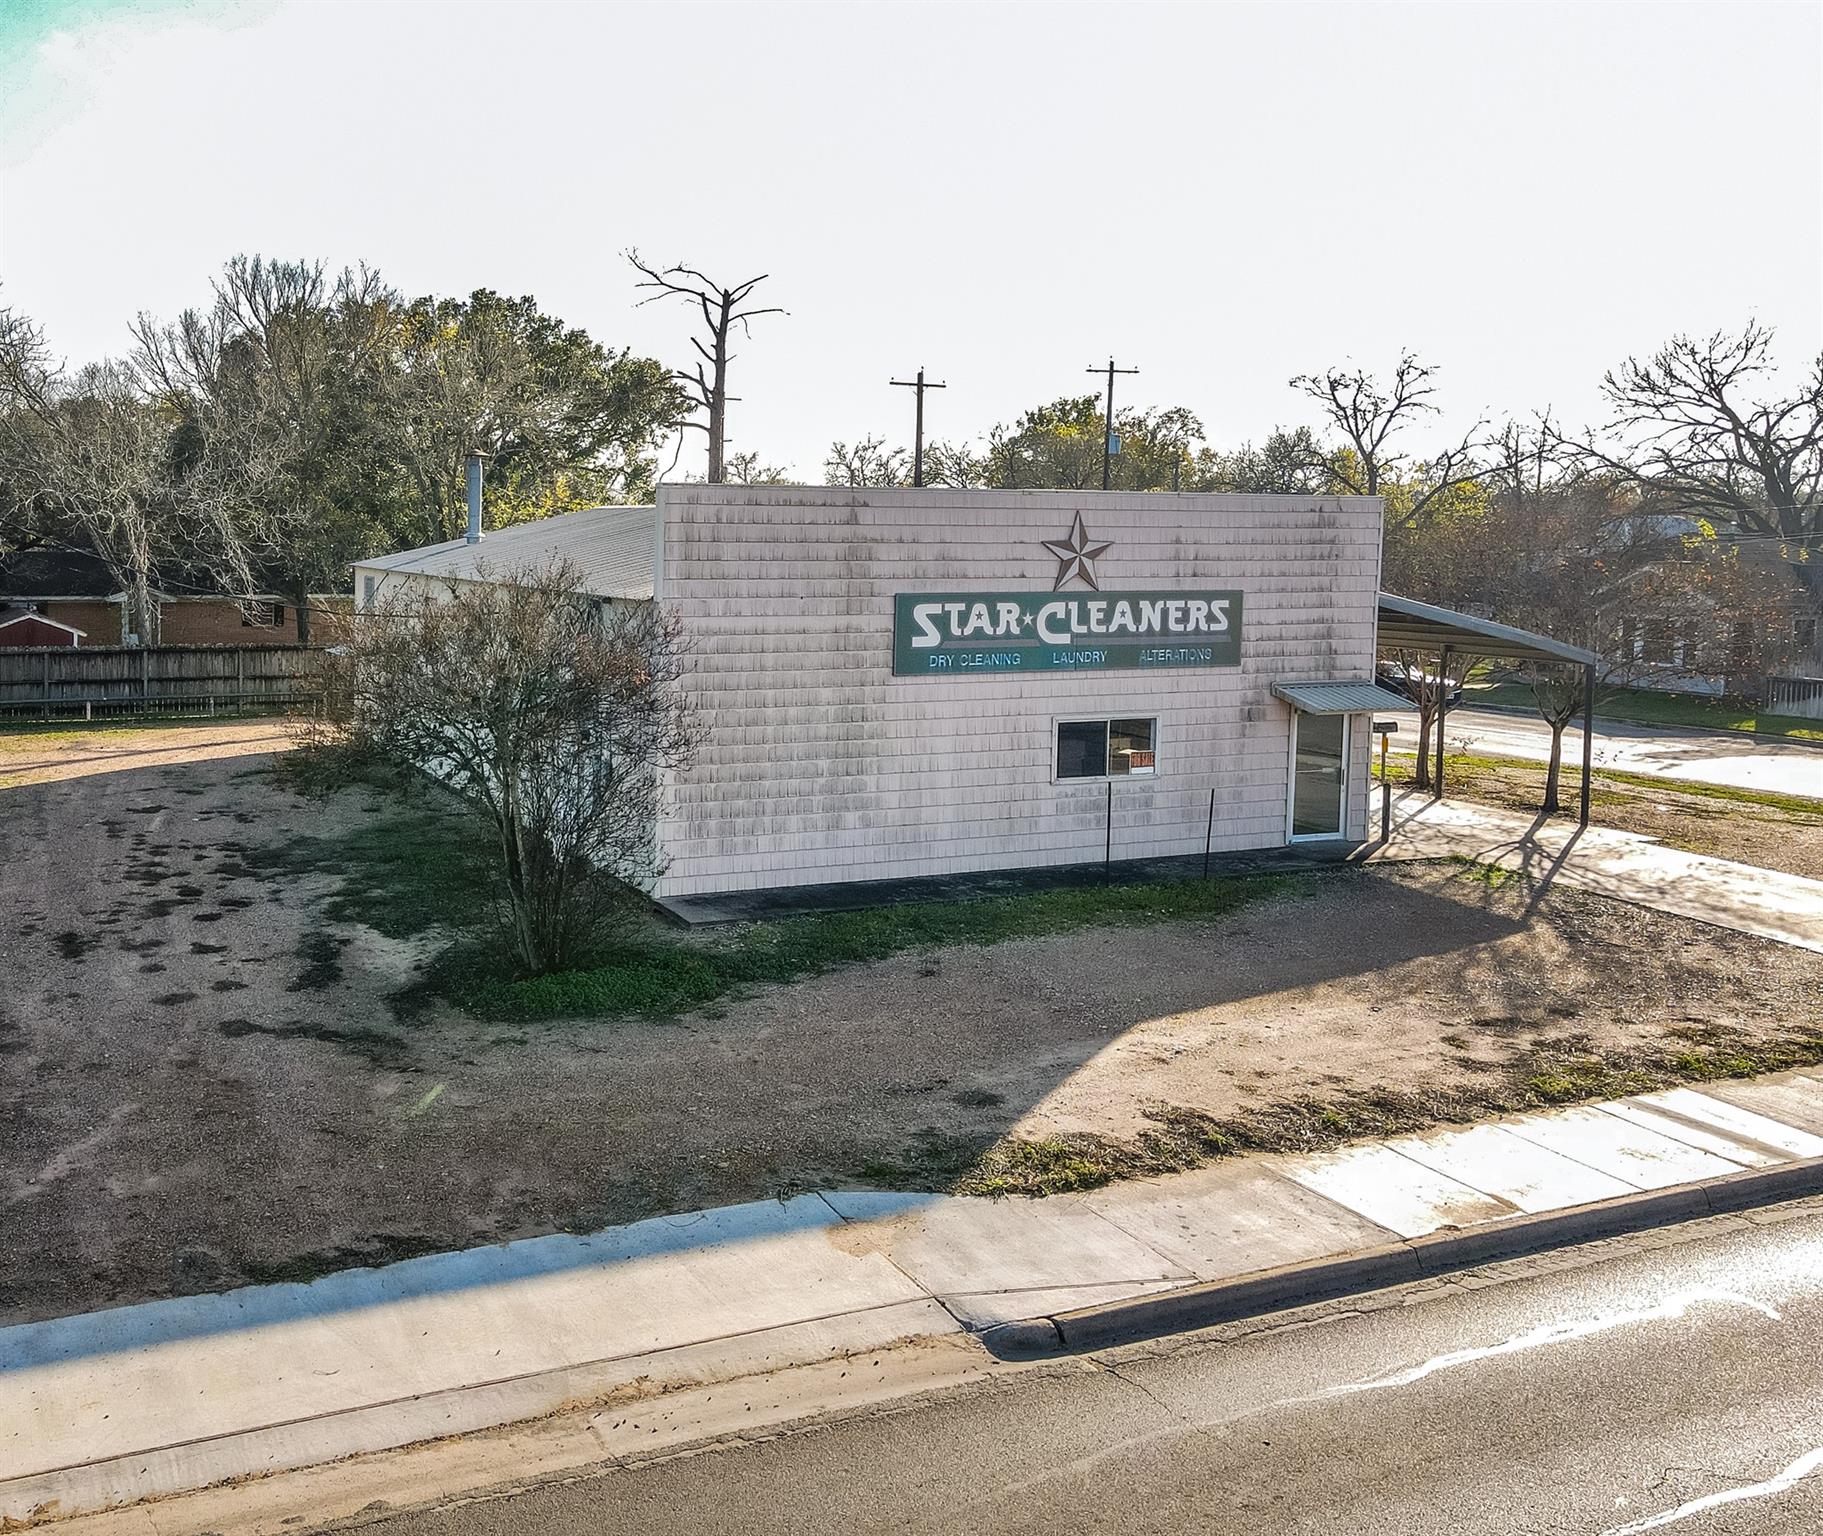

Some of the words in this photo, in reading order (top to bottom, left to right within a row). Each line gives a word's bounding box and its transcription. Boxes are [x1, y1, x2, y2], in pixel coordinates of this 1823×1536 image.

[912, 602, 1020, 648] STAR
[1036, 600, 1229, 644] CLEANERS
[929, 655, 954, 667] DRY
[960, 653, 1021, 667] CLEANING
[1053, 650, 1108, 664] LAUNDRY
[1139, 648, 1212, 662] ALTERATIONS
